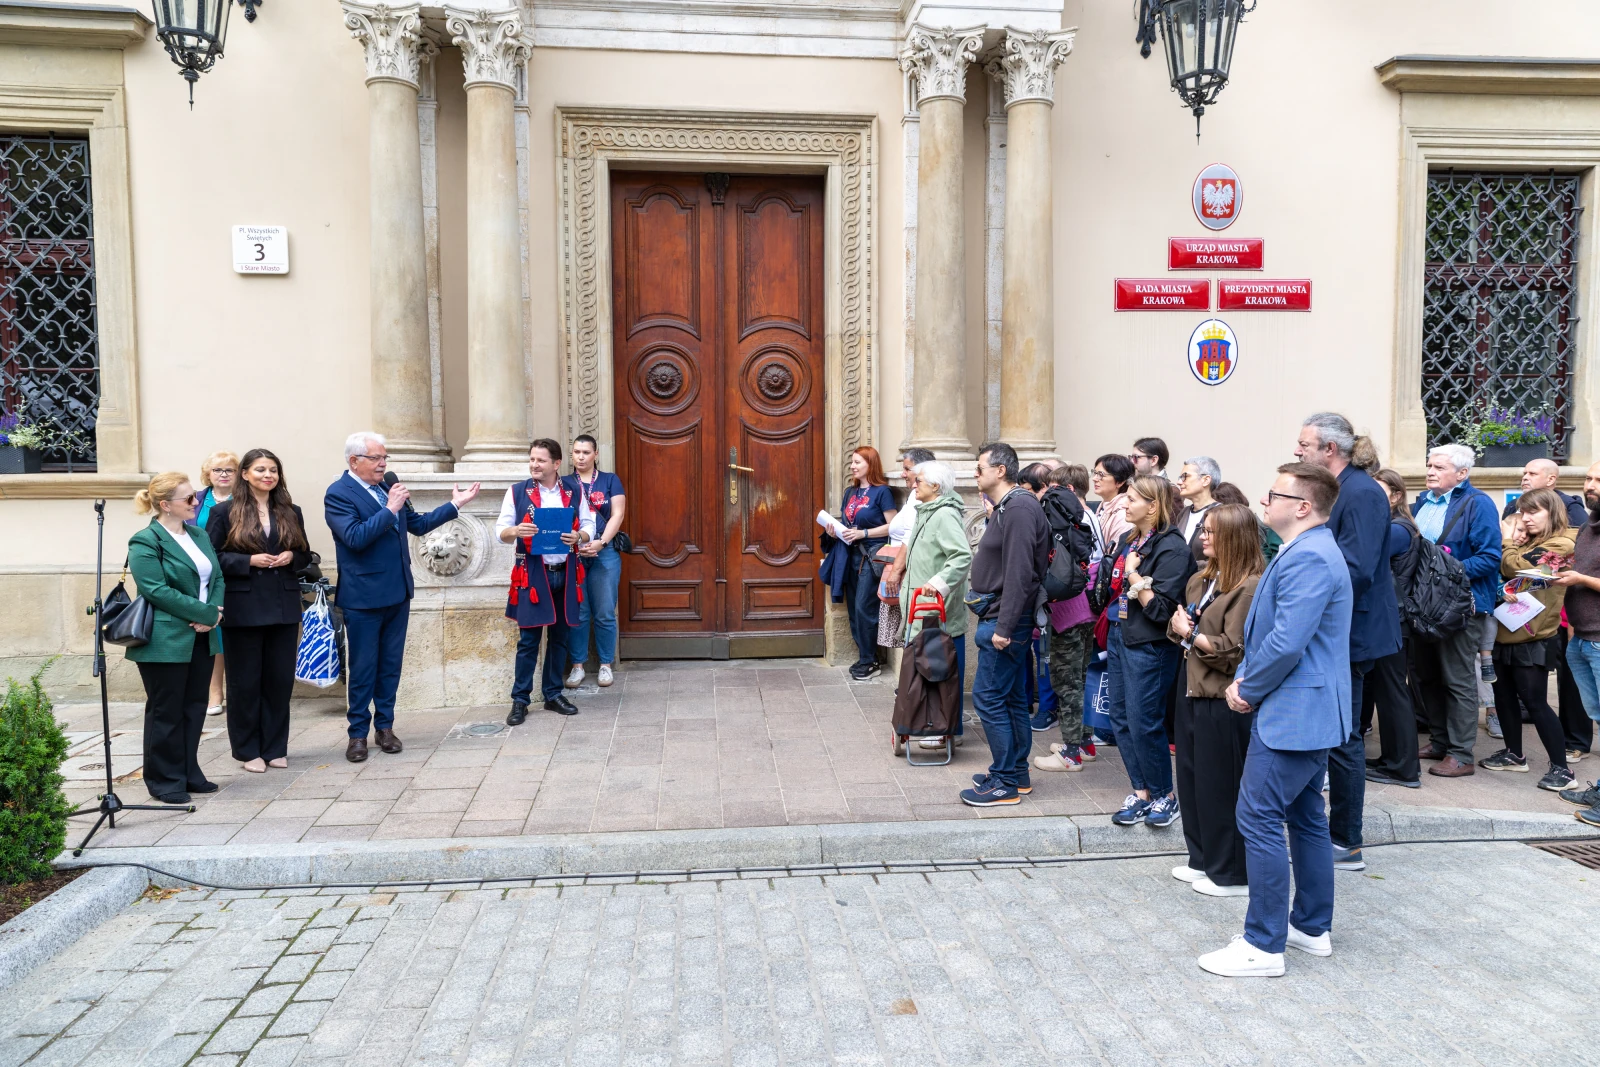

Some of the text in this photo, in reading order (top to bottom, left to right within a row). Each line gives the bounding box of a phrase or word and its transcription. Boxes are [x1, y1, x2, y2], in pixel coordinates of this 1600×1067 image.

[254, 243, 265, 261] 3
[1186, 244, 1249, 254] URZĄD MIASTA
[1196, 256, 1238, 264] KRAKOWA
[1135, 285, 1192, 293] RADA MIASTA
[1225, 285, 1307, 294] PREZYDENT MIASTA
[1142, 296, 1185, 305] KRAKOWA
[1245, 296, 1287, 305] KRAKOWA
